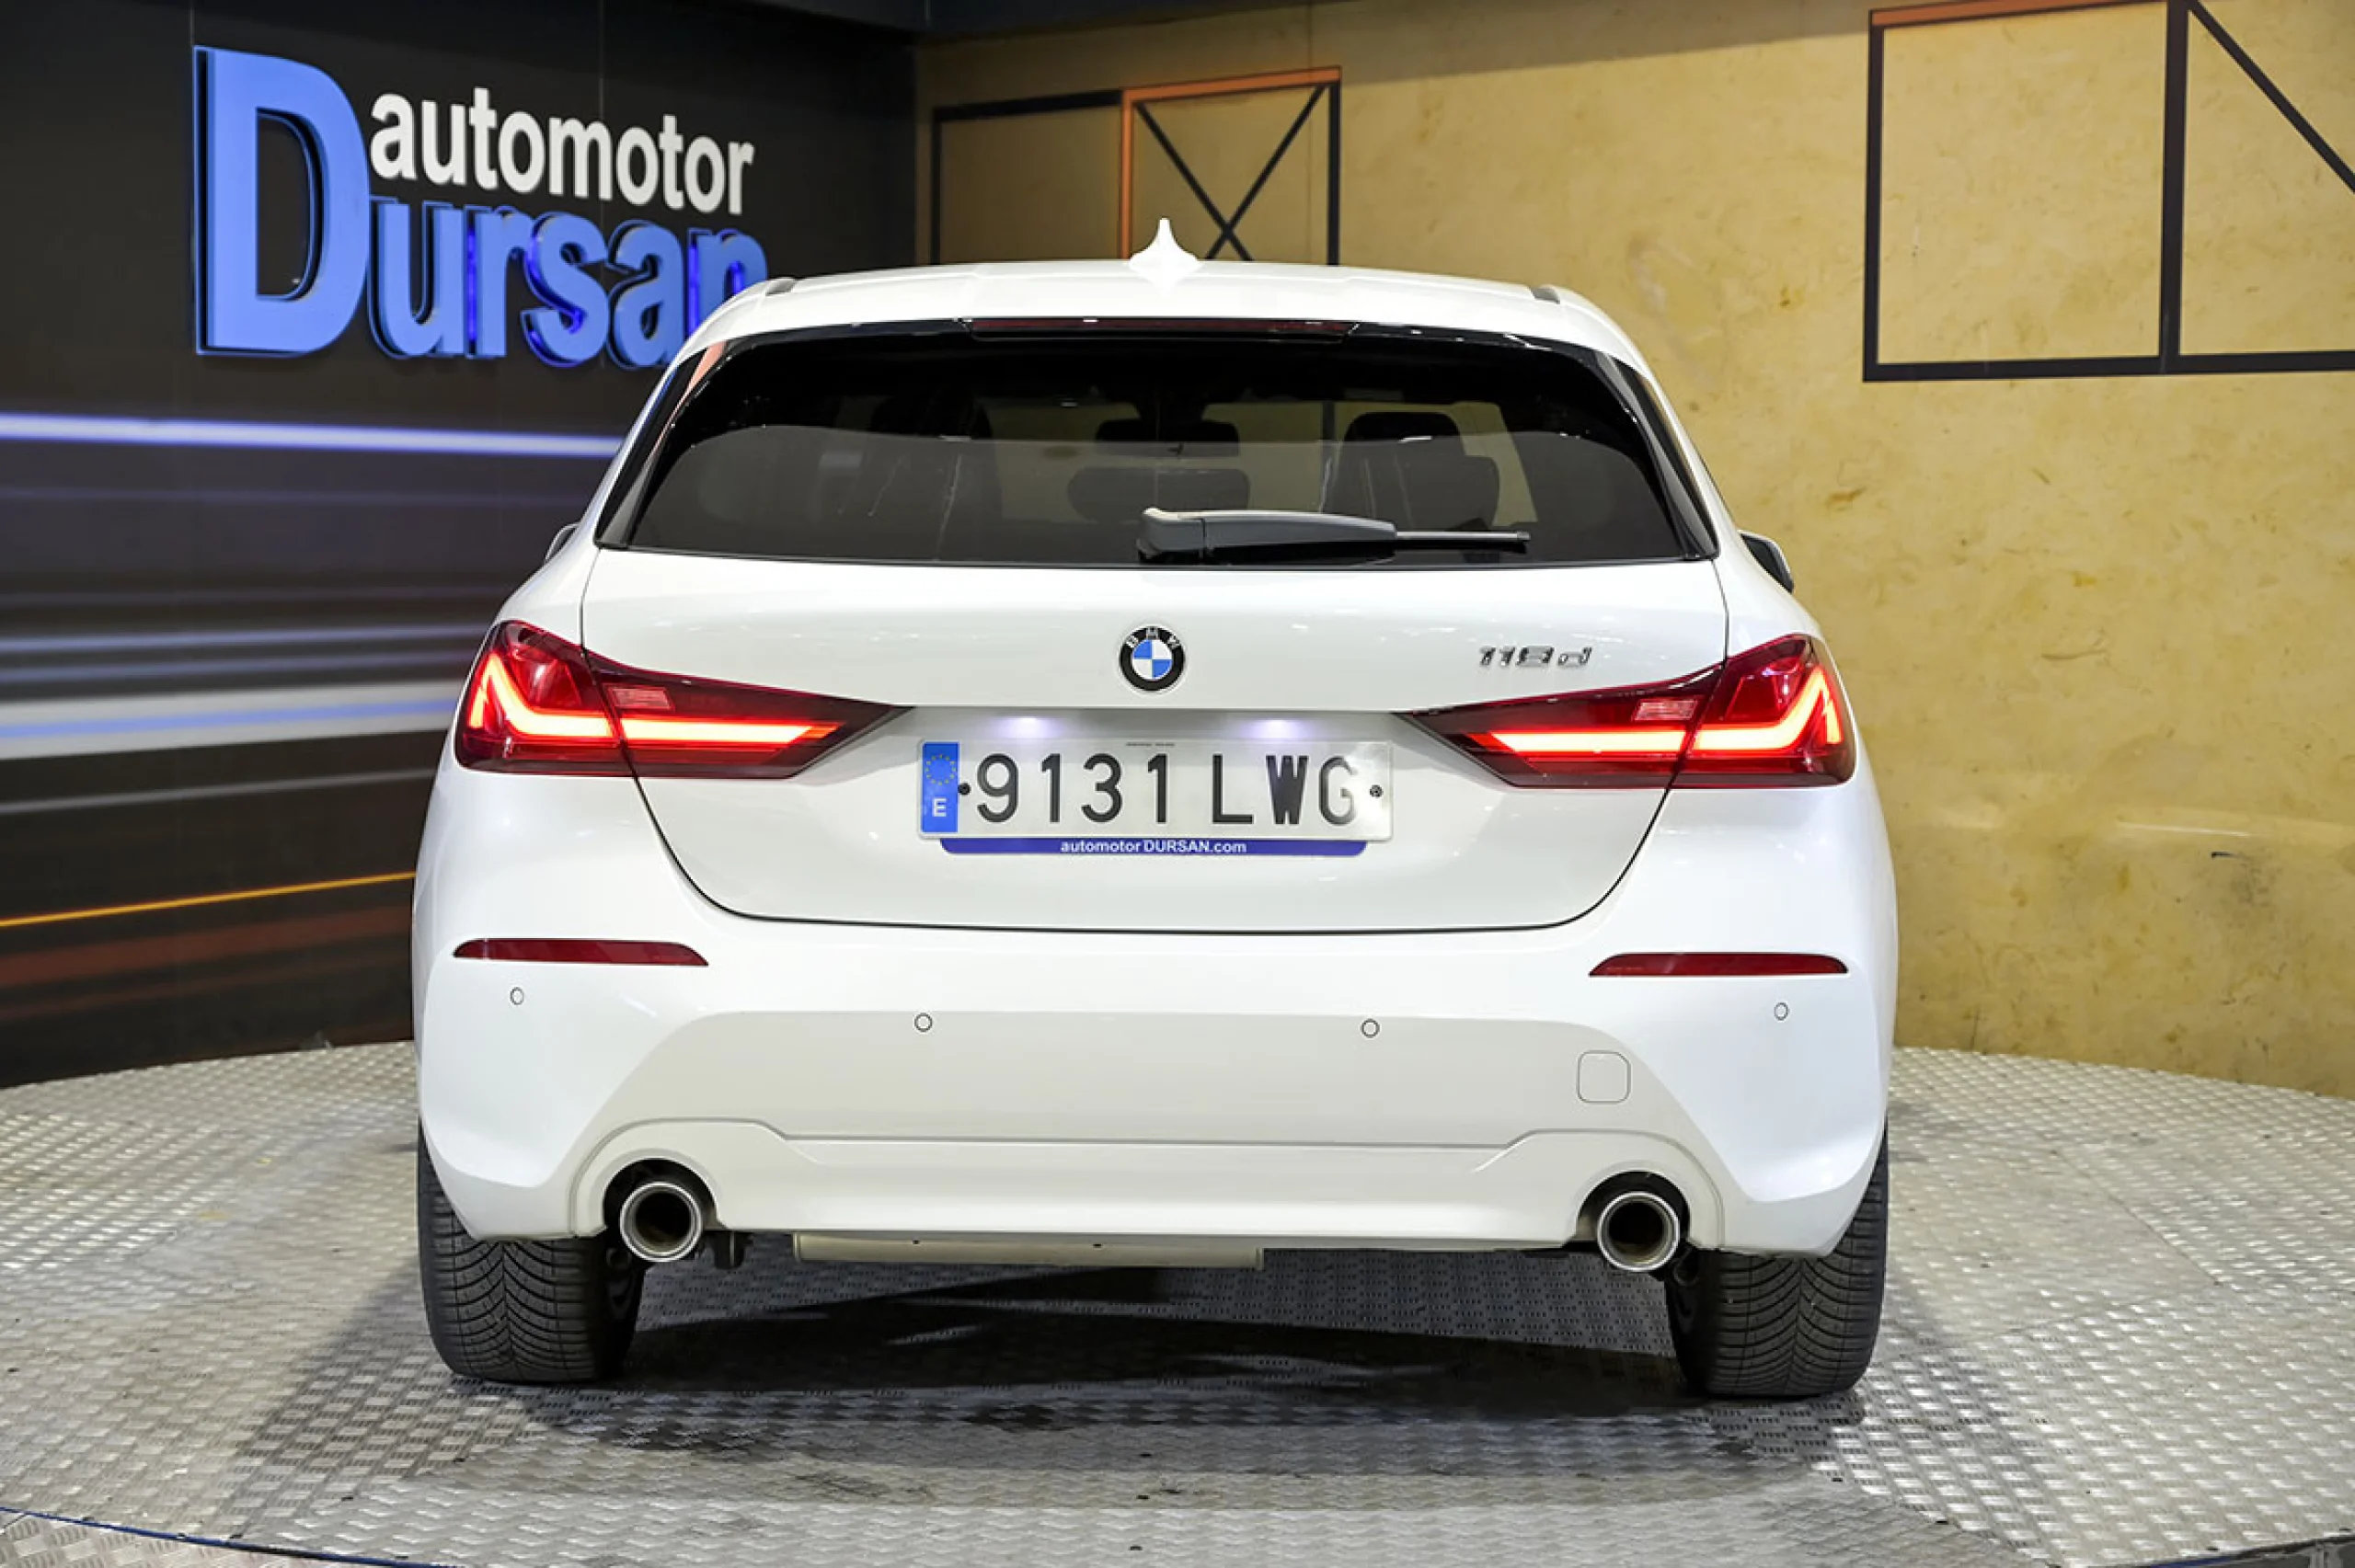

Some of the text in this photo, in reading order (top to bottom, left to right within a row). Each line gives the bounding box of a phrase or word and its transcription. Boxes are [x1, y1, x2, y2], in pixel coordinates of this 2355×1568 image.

[370, 87, 754, 215] automotor
[1479, 646, 1592, 669] 118d
[932, 796, 947, 818] E
[976, 752, 1357, 826] 9131 LWG
